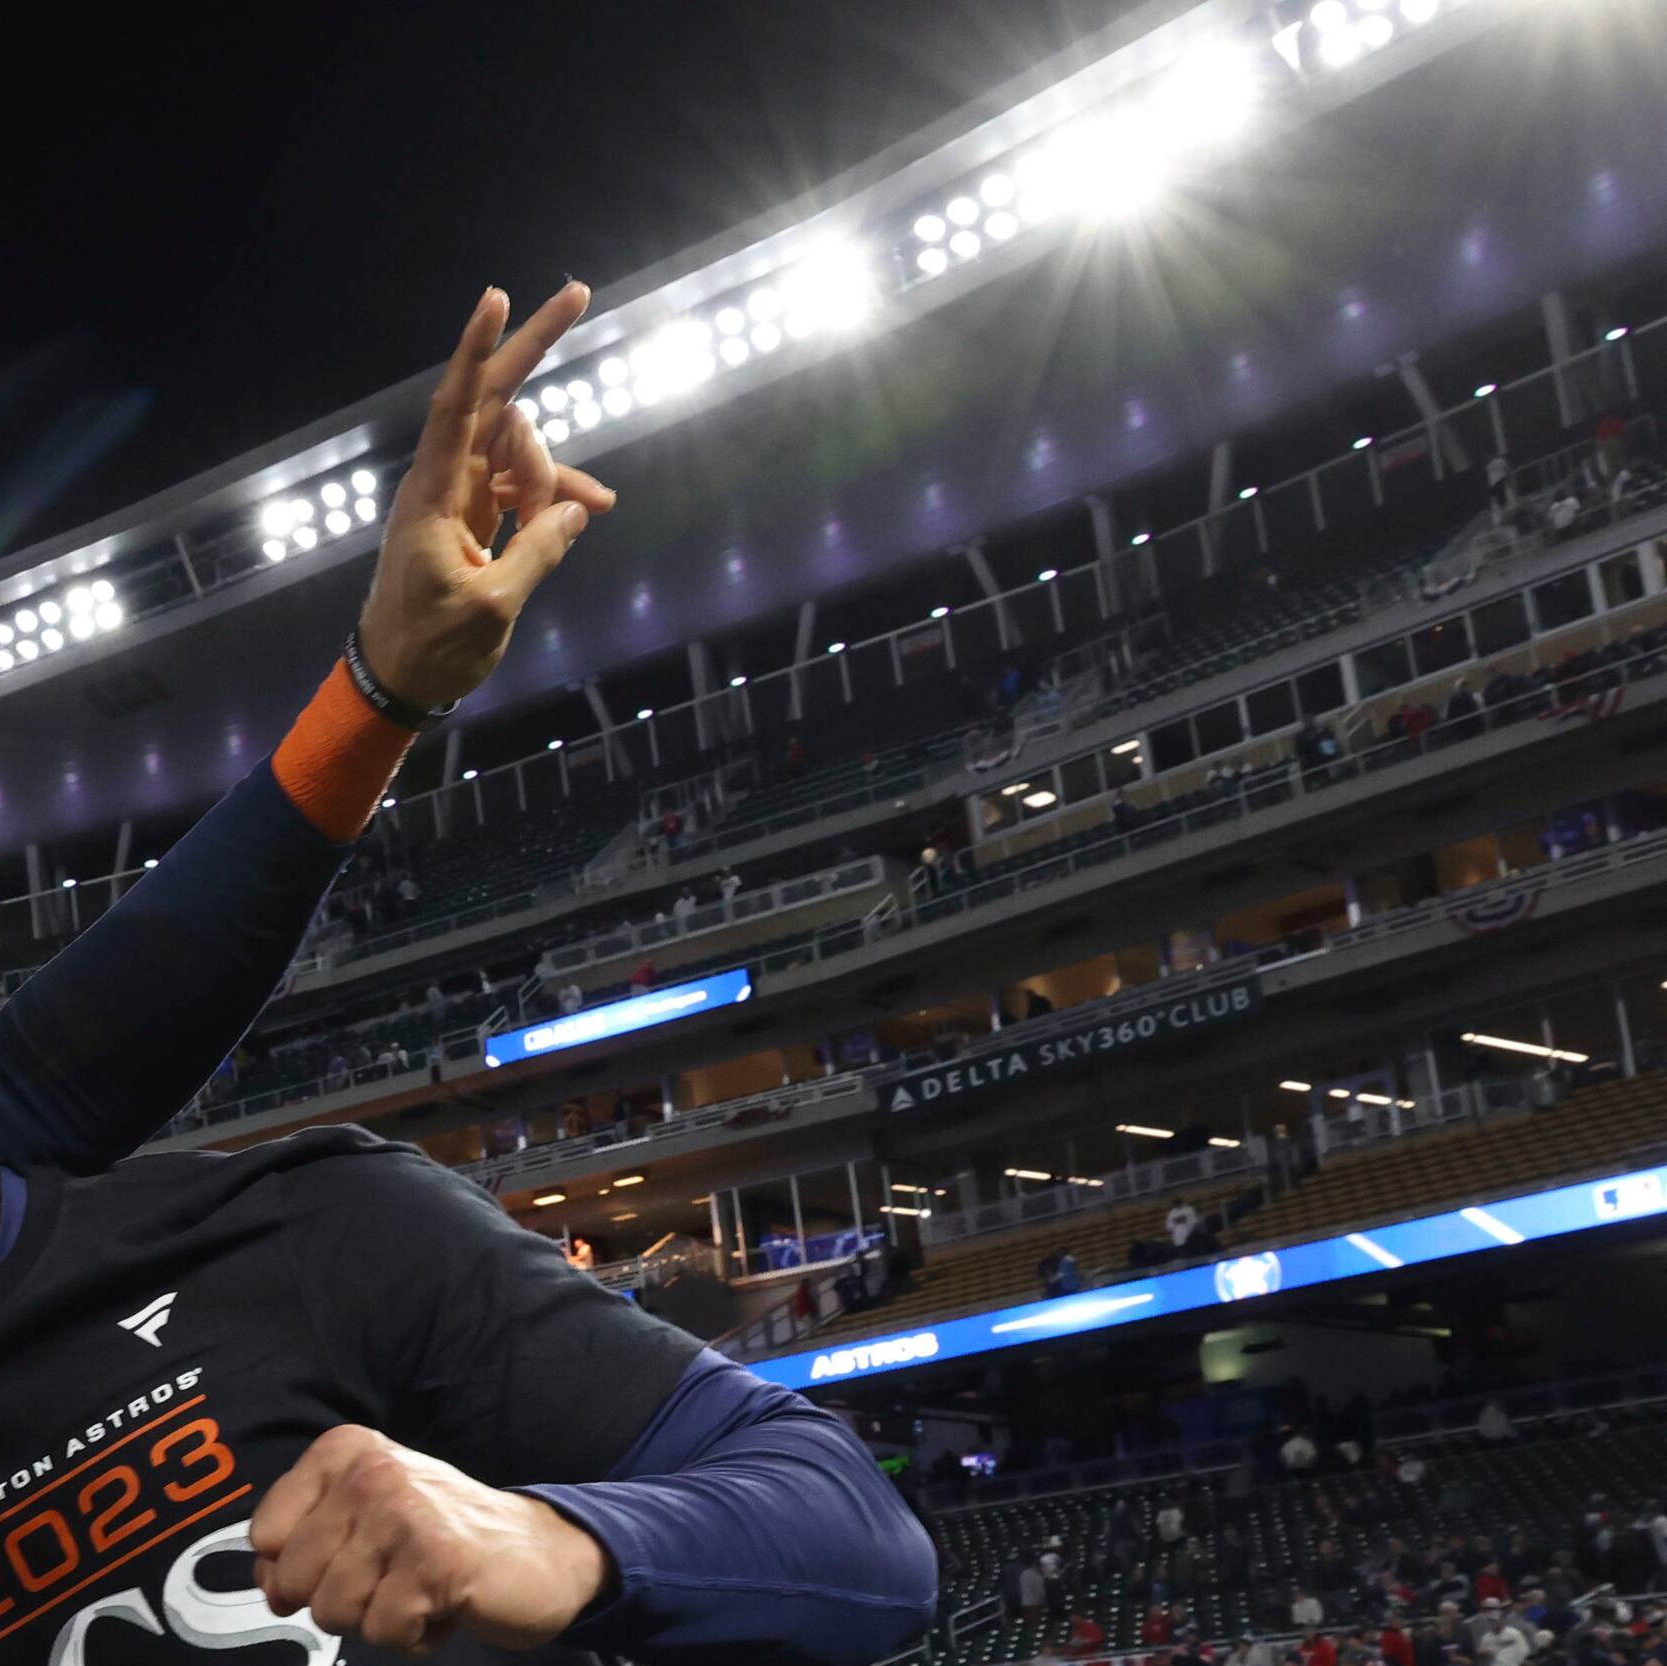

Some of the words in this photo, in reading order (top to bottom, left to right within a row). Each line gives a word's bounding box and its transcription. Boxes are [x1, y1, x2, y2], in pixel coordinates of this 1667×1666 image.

[922, 1053, 1028, 1100] DELTA
[1169, 987, 1251, 1029] CLUB
[810, 1332, 939, 1379] ASTROS
[66, 1368, 202, 1458] ASTROS
